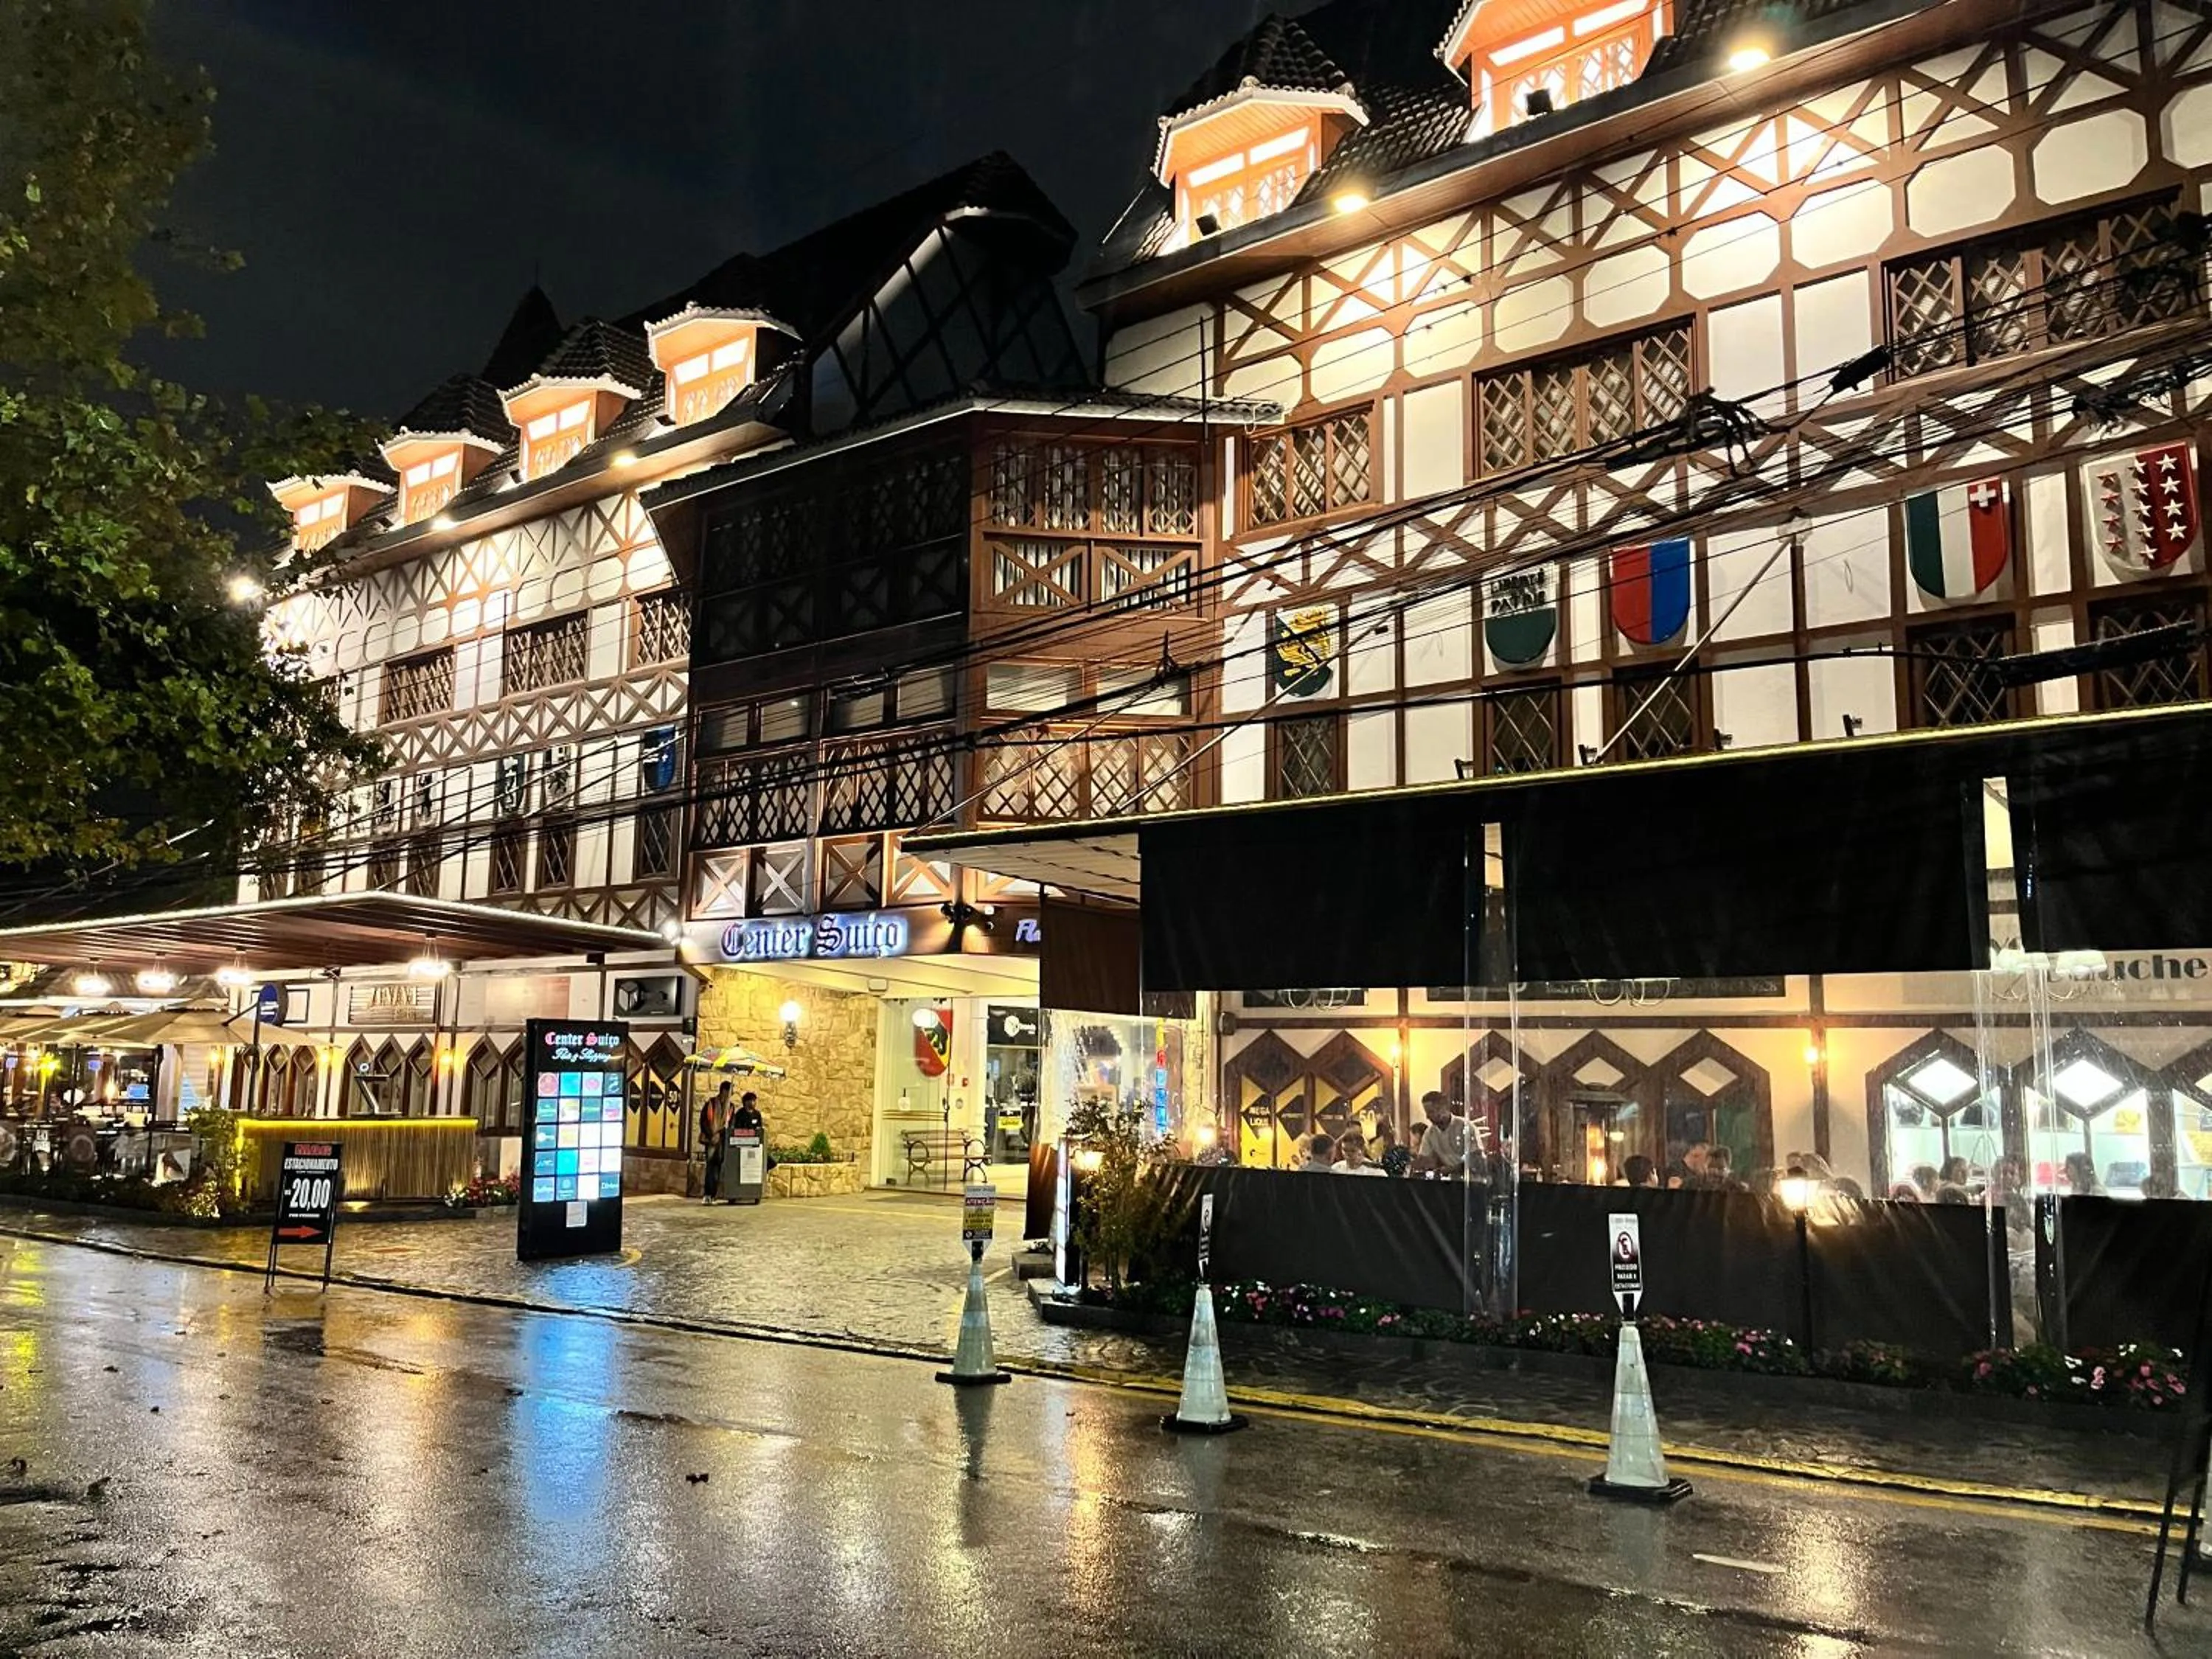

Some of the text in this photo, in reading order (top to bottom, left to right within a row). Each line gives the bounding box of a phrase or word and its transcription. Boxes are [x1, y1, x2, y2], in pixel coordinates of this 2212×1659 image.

[720, 922, 807, 958] Center
[545, 1032, 583, 1046] Center
[289, 1178, 331, 1211] 20,00
